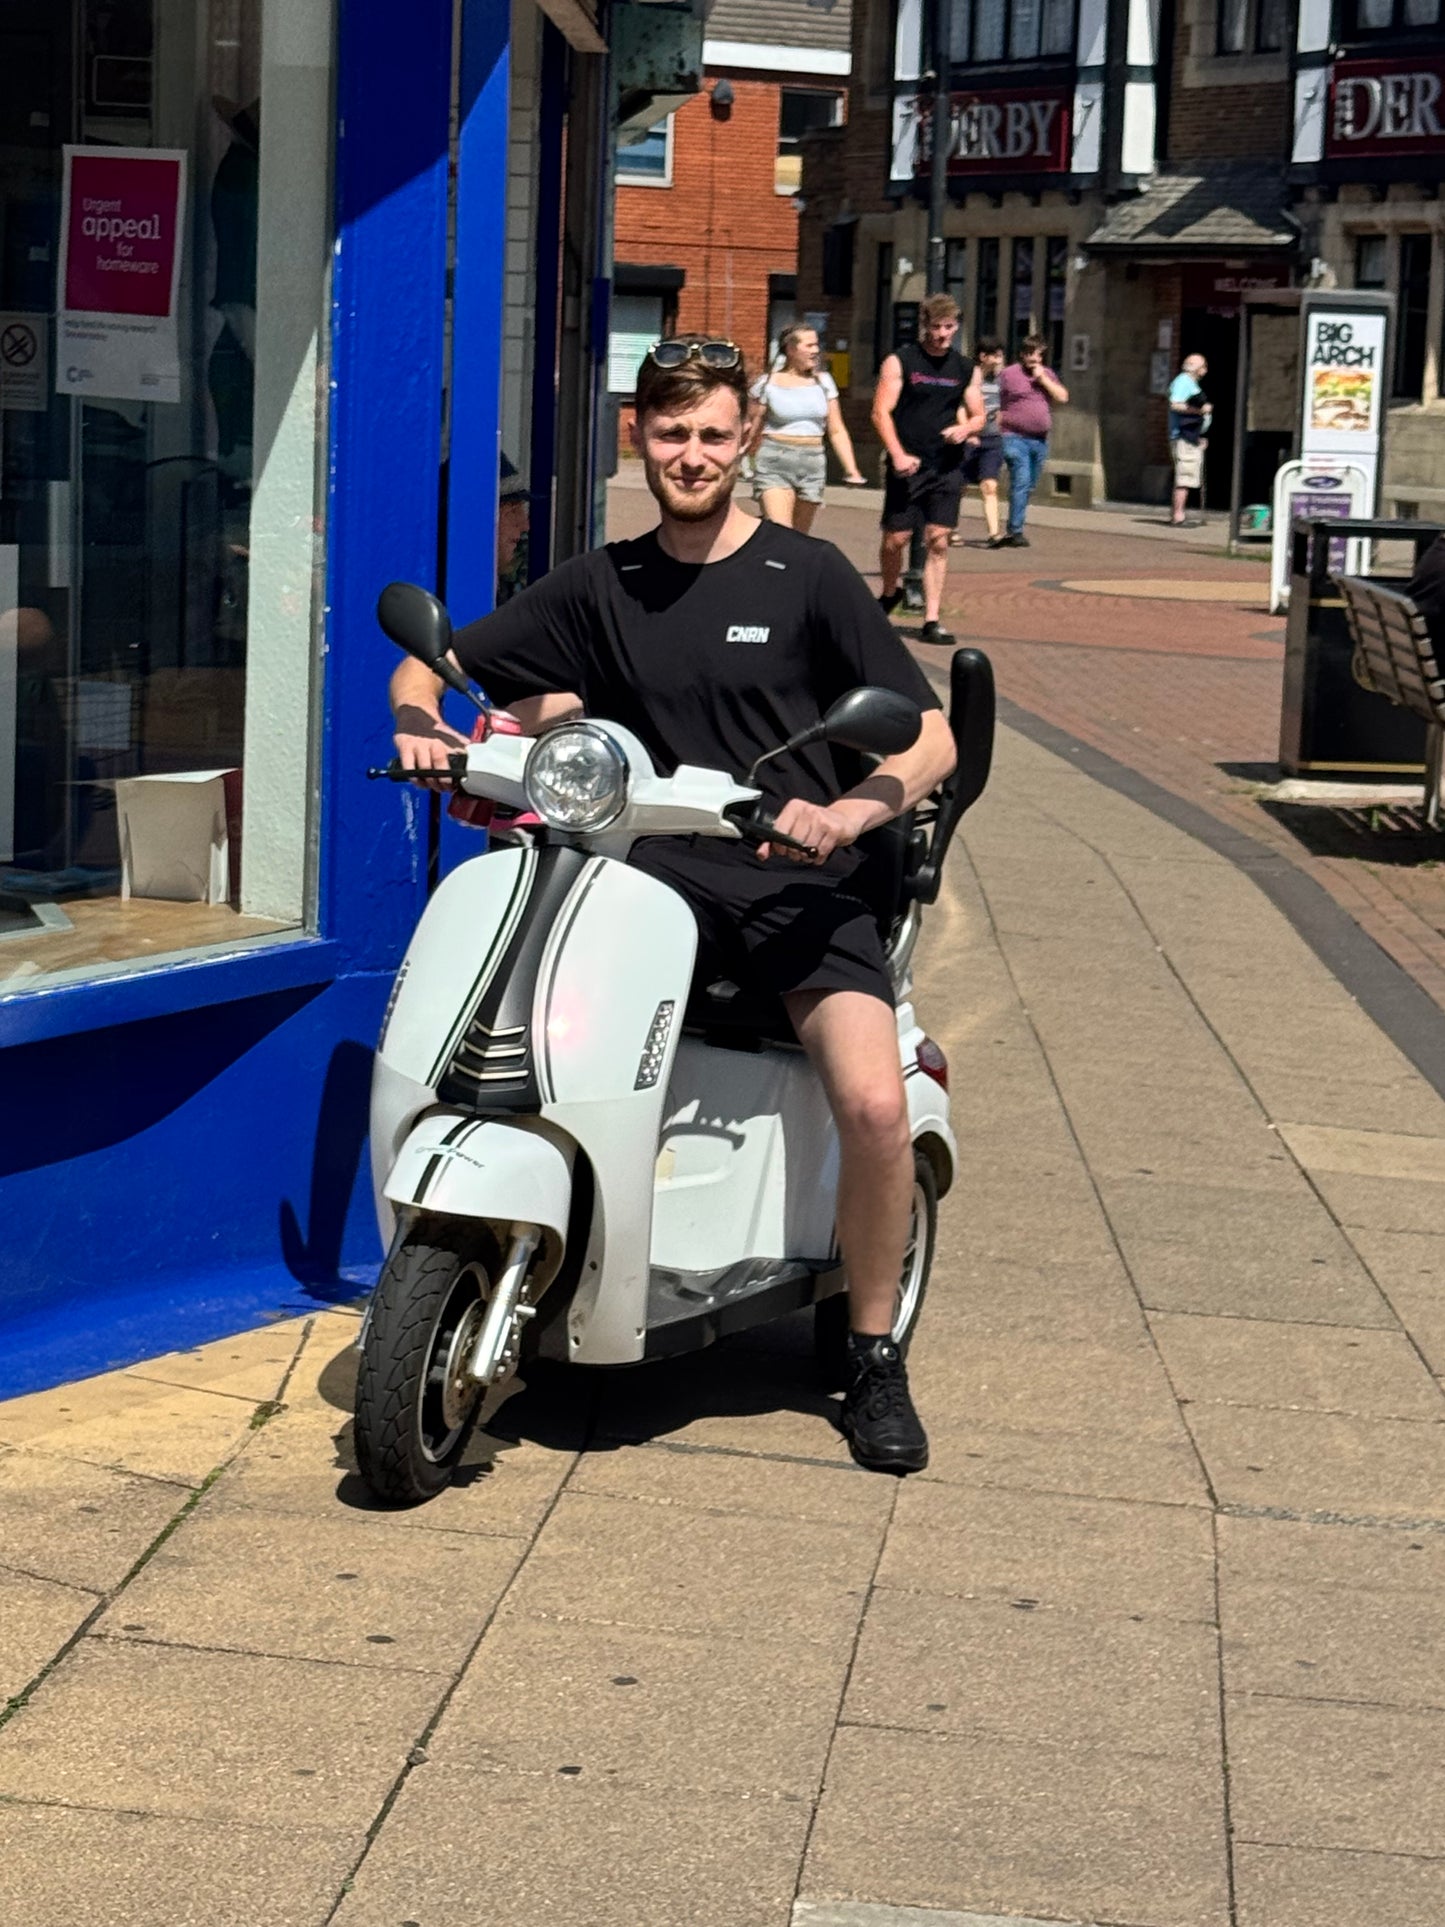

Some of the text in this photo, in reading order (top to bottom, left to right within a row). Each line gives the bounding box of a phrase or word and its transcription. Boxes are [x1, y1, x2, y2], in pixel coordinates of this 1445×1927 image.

[82, 198, 122, 214] Urgent
[82, 214, 161, 242] appeal
[116, 241, 133, 257] for
[96, 255, 159, 274] homeware
[1318, 322, 1353, 343] BIG
[1311, 344, 1376, 368] ARCH
[726, 626, 770, 643] CNRN
